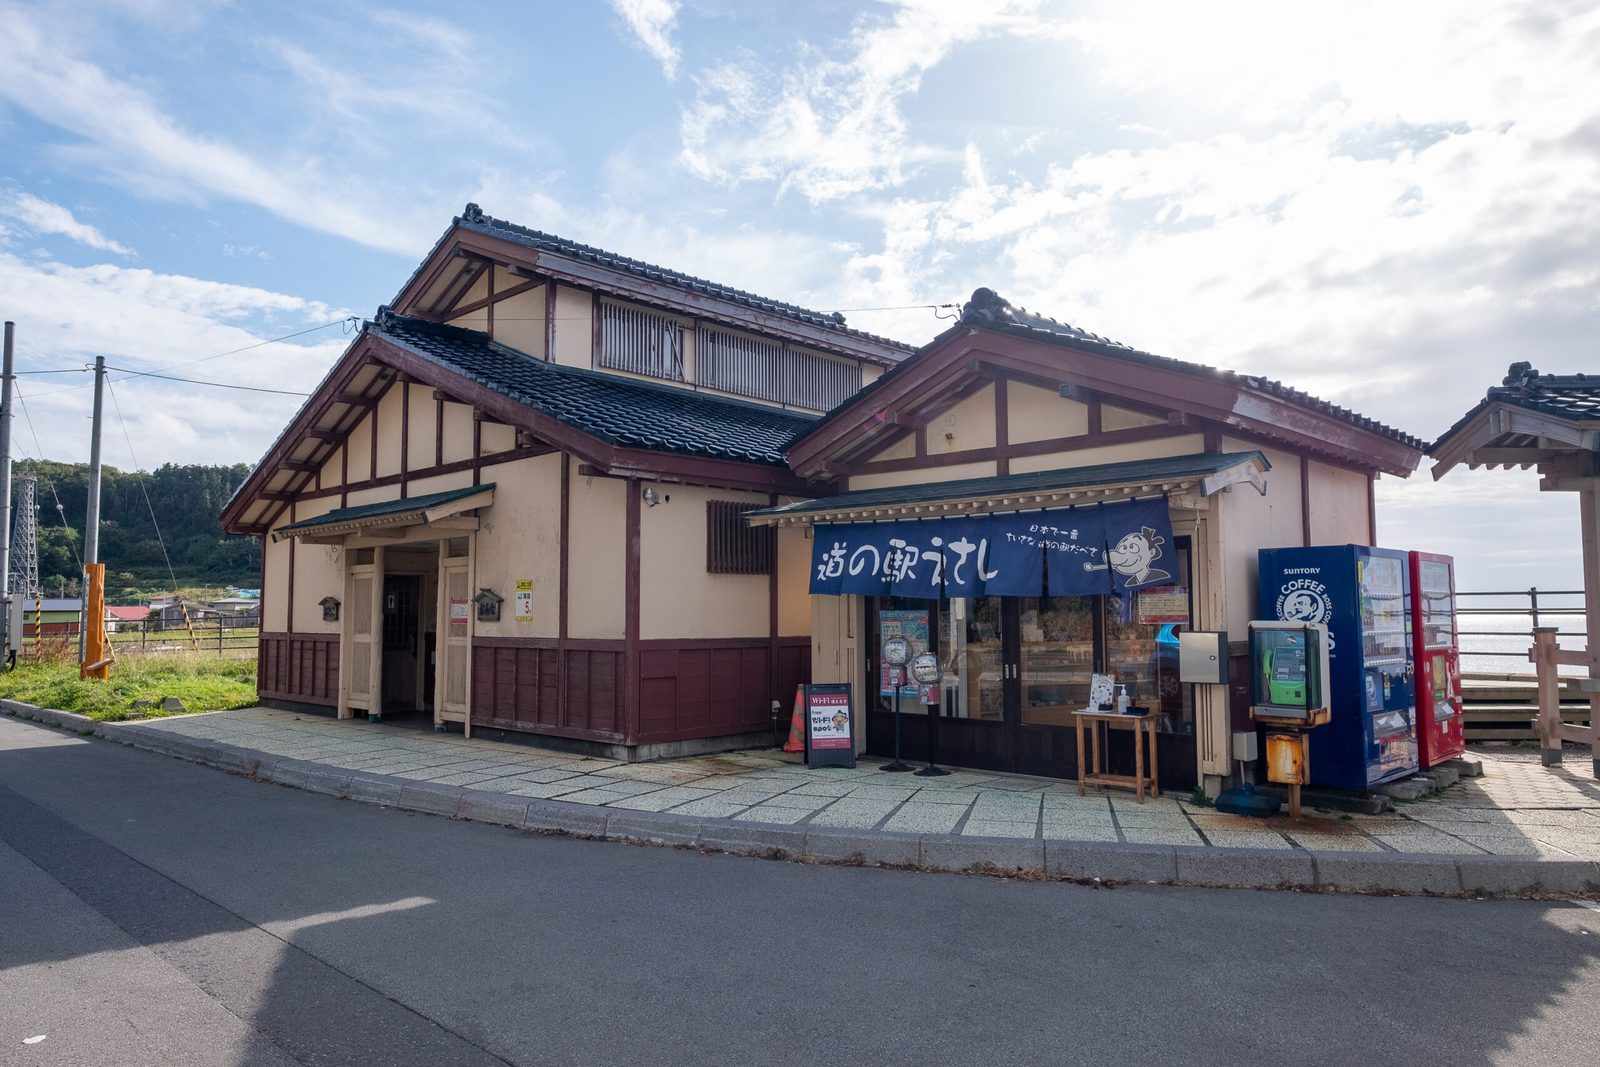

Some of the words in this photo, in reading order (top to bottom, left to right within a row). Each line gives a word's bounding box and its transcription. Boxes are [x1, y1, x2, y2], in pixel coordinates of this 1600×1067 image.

[1029, 524, 1079, 540] 日本で一番
[817, 536, 999, 586] 道の駅えさし
[1283, 567, 1321, 575] SUNTORY
[1281, 579, 1326, 594] COFFEE
[1276, 594, 1286, 617] COFFEE
[1321, 593, 1333, 610] BOSS
[1321, 610, 1332, 624] COF
